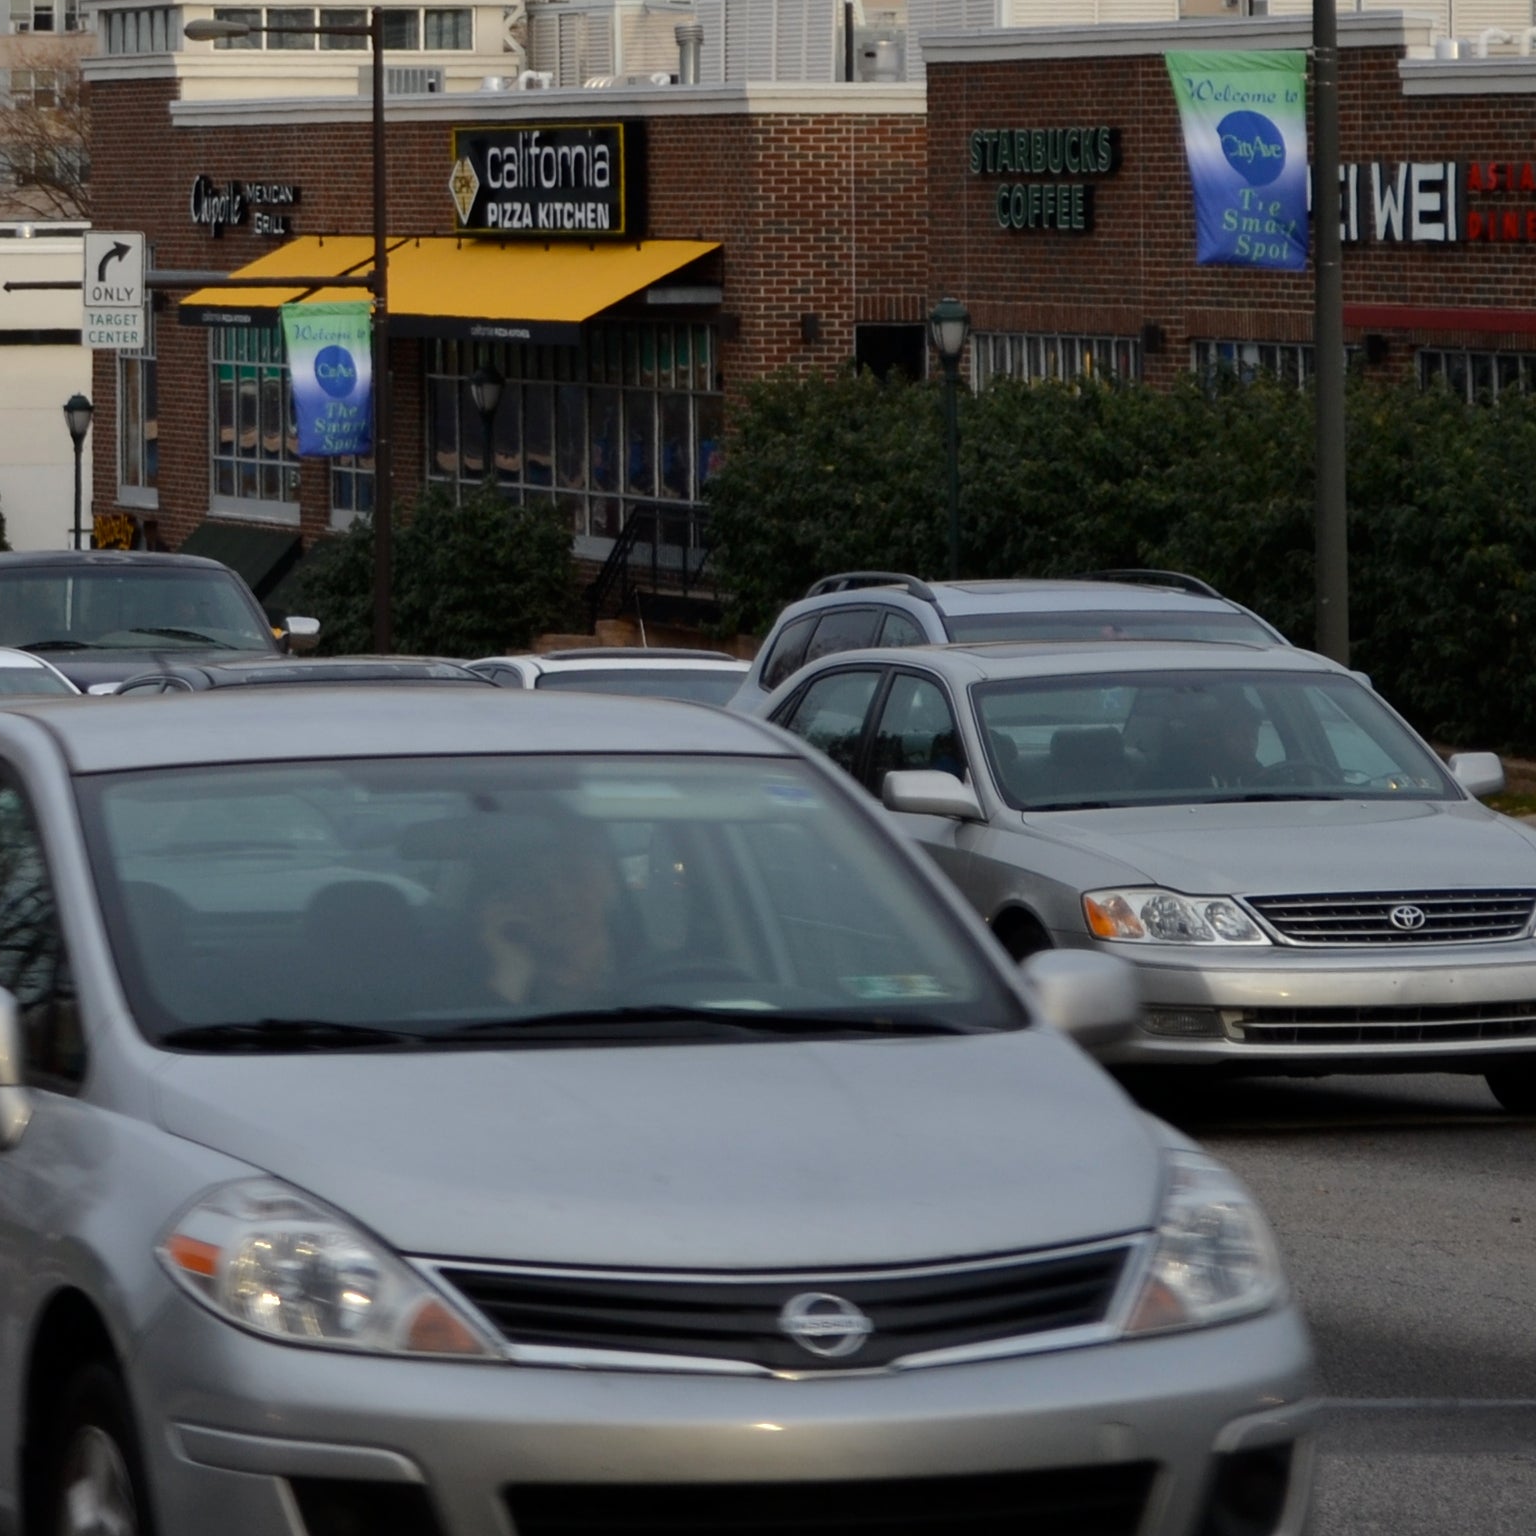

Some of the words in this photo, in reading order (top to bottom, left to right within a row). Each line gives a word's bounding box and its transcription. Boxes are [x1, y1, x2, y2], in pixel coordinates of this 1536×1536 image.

[1185, 78, 1276, 103] Welcome
[1285, 89, 1298, 103] to
[487, 129, 610, 189] california
[970, 126, 1112, 173] STARBUCKS
[190, 175, 241, 238] Chipotle
[246, 184, 293, 203] MEXICAN
[997, 183, 1085, 229] COFFEE
[1371, 162, 1457, 241] WEI
[254, 212, 285, 234] GRILL
[487, 202, 533, 229] PIZZA
[538, 203, 610, 229] KITCHEN
[1235, 234, 1289, 261] Spot
[92, 287, 134, 301] ONLY
[89, 314, 137, 327] TARGET
[88, 331, 138, 344] CENTER
[326, 403, 358, 418] The
[314, 417, 366, 433] Smart
[323, 436, 359, 451] Spot
